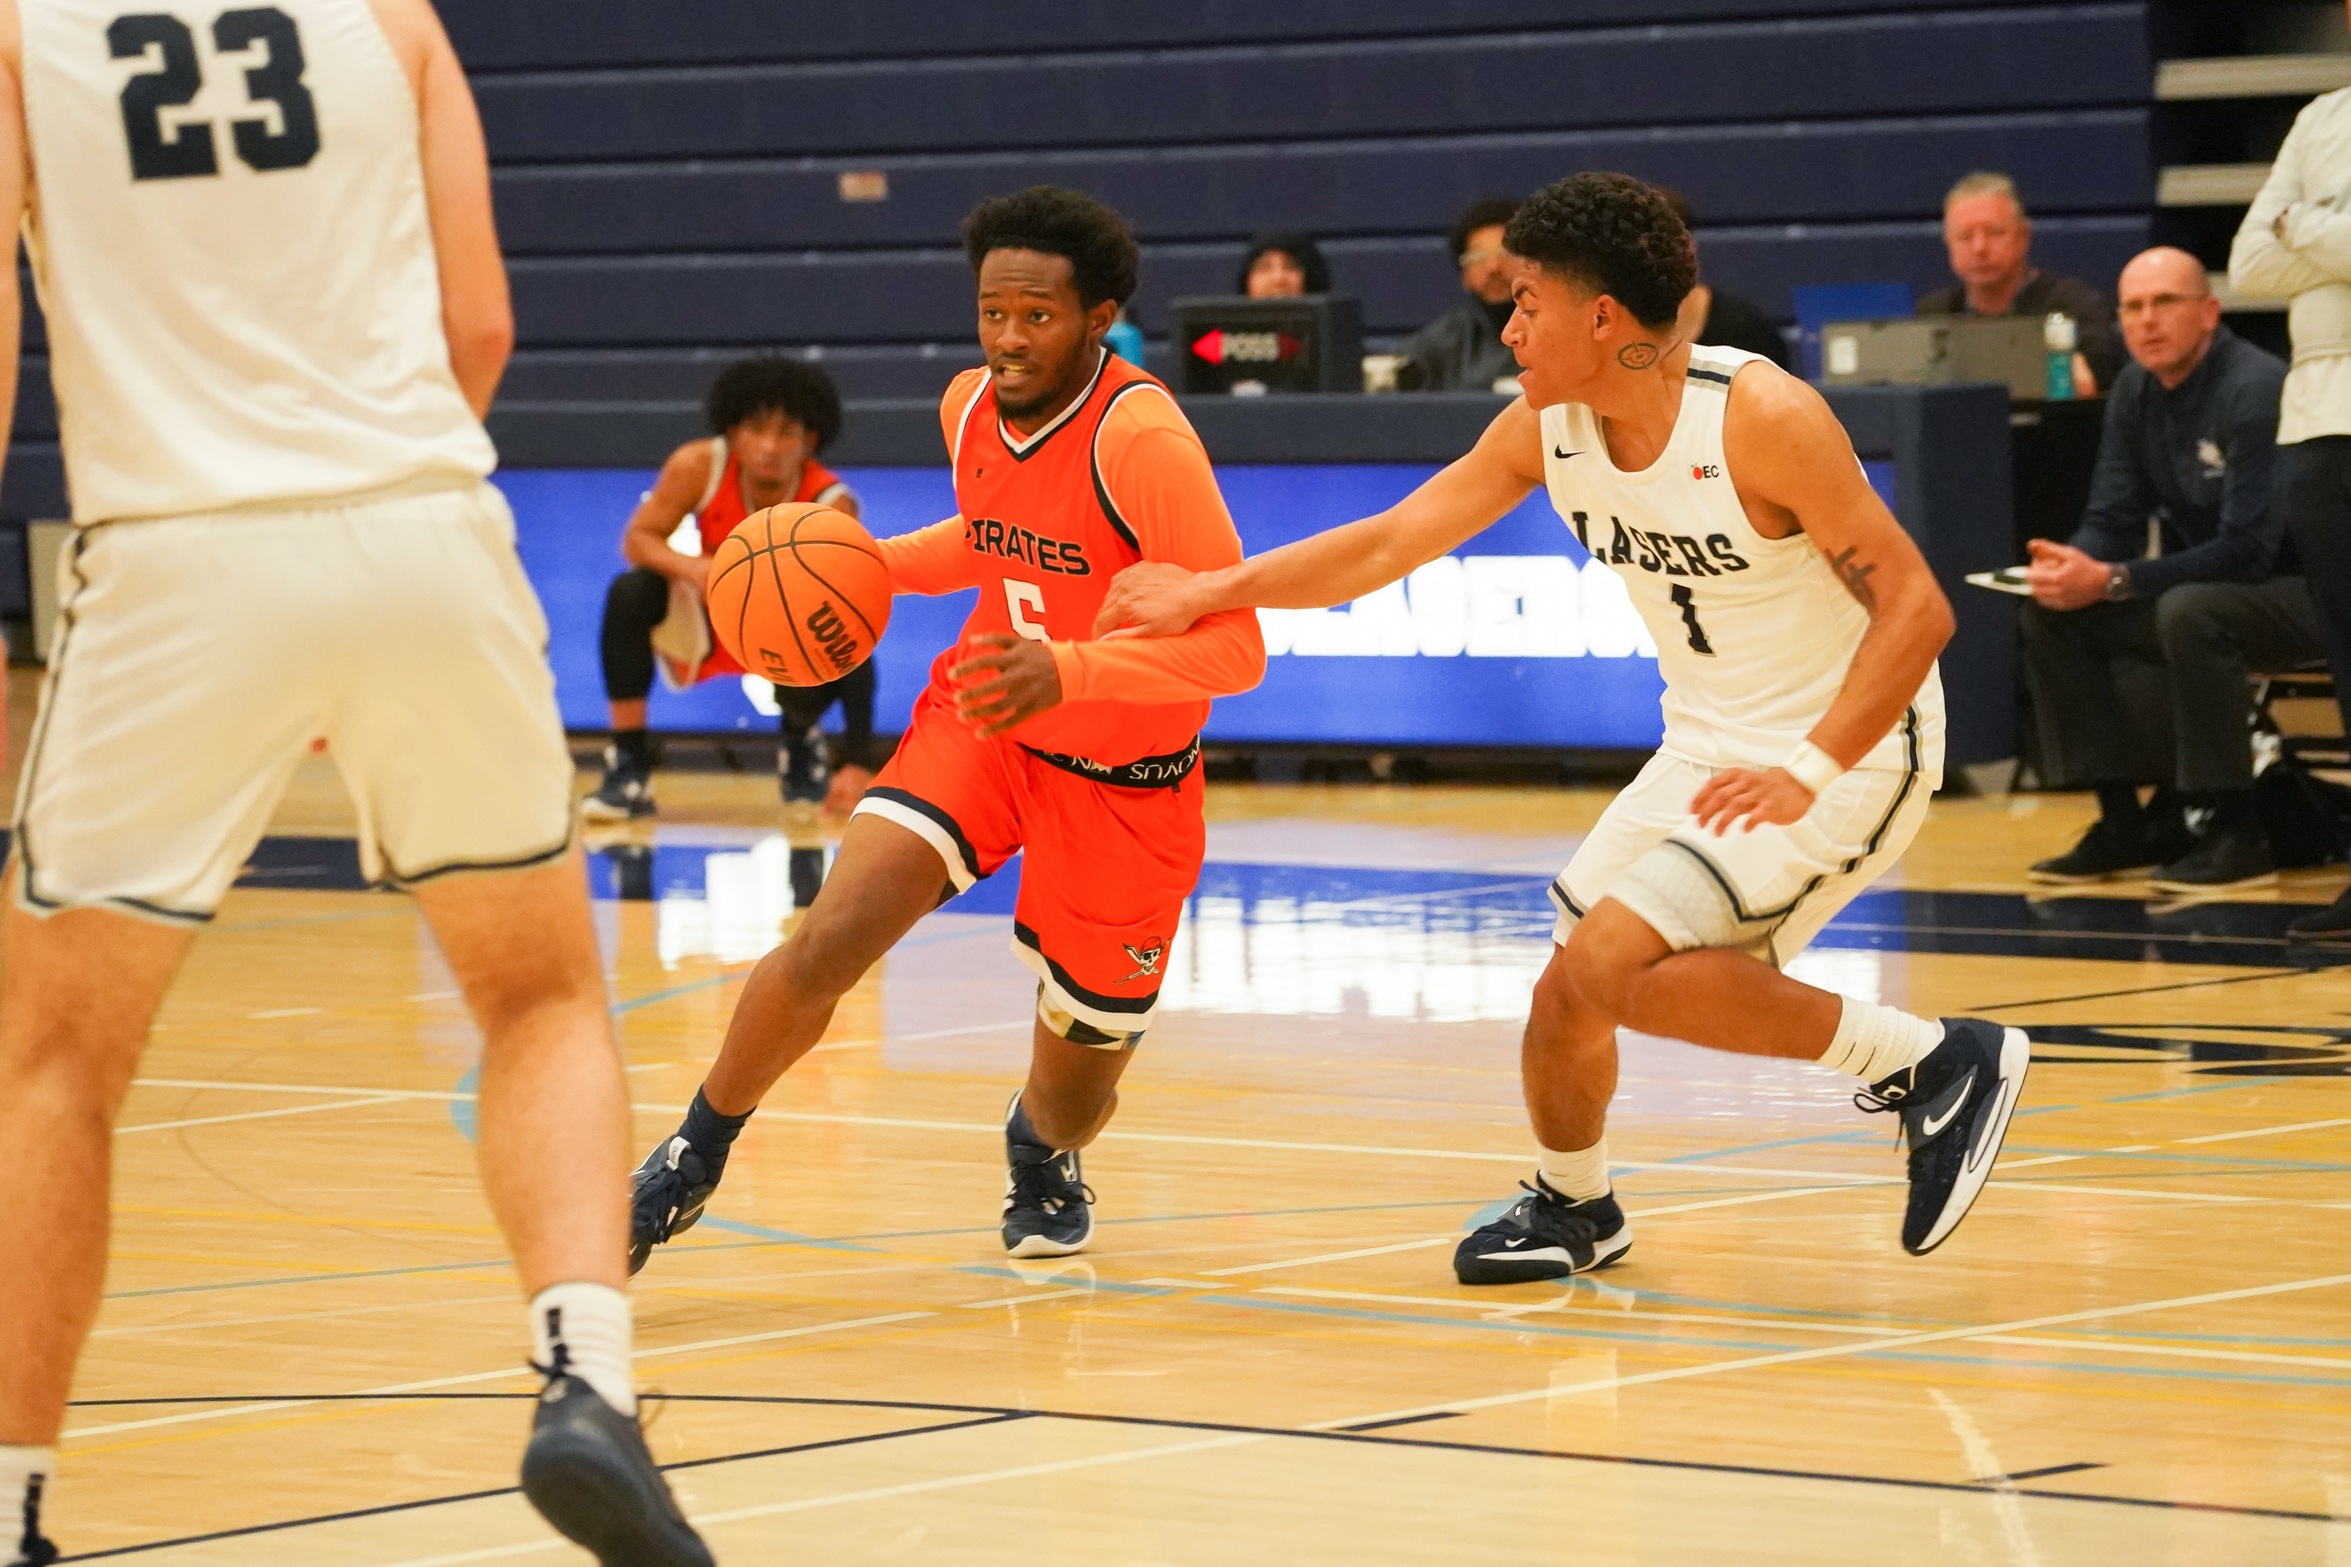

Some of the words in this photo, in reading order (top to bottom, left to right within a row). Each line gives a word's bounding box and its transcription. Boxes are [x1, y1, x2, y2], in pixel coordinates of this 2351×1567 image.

[106, 7, 321, 181] 23
[966, 519, 1091, 576] IRATES
[1572, 511, 1750, 577] LASERS
[1671, 583, 1716, 657] 1
